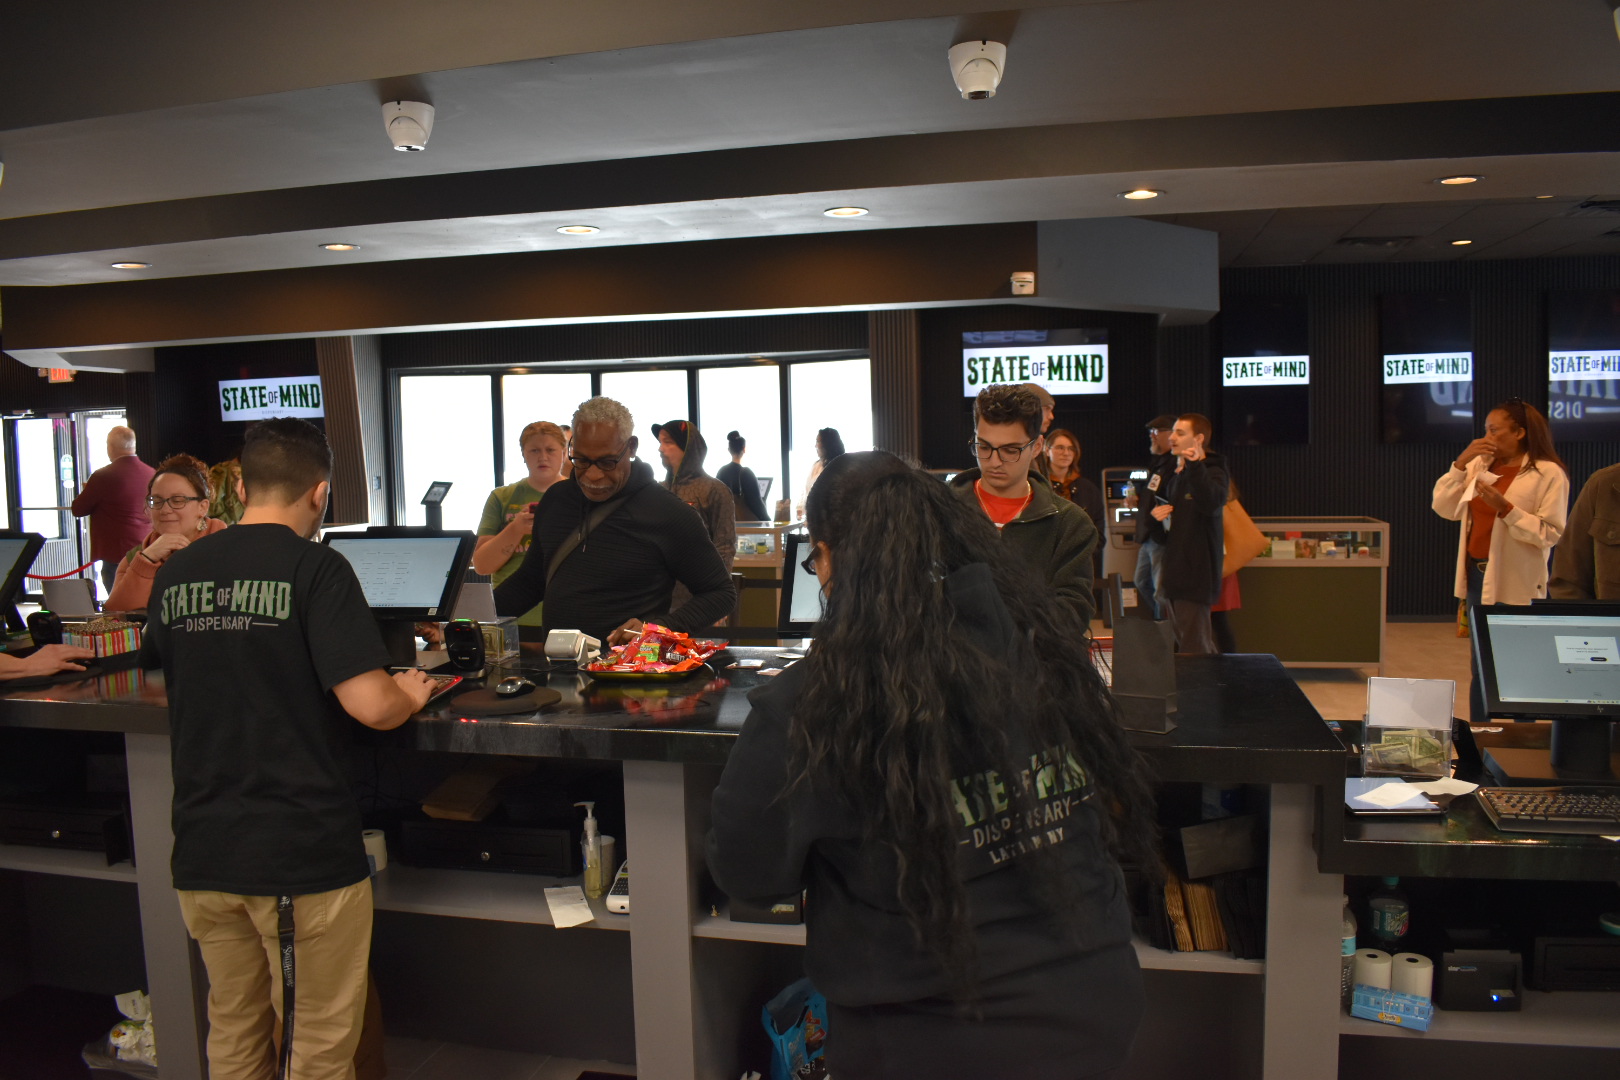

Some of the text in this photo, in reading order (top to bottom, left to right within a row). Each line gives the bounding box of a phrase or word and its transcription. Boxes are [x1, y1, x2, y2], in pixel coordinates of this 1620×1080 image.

[967, 354, 1104, 385] STATE OF MIND
[1225, 360, 1306, 379] STATE OF MIND
[1386, 357, 1469, 377] STATE OF MIND
[1551, 355, 1620, 374] STATE OF MI
[221, 383, 321, 412] STATE OF MIND
[160, 579, 292, 625] STATE OF MIND
[186, 616, 252, 632] DISPENSARY
